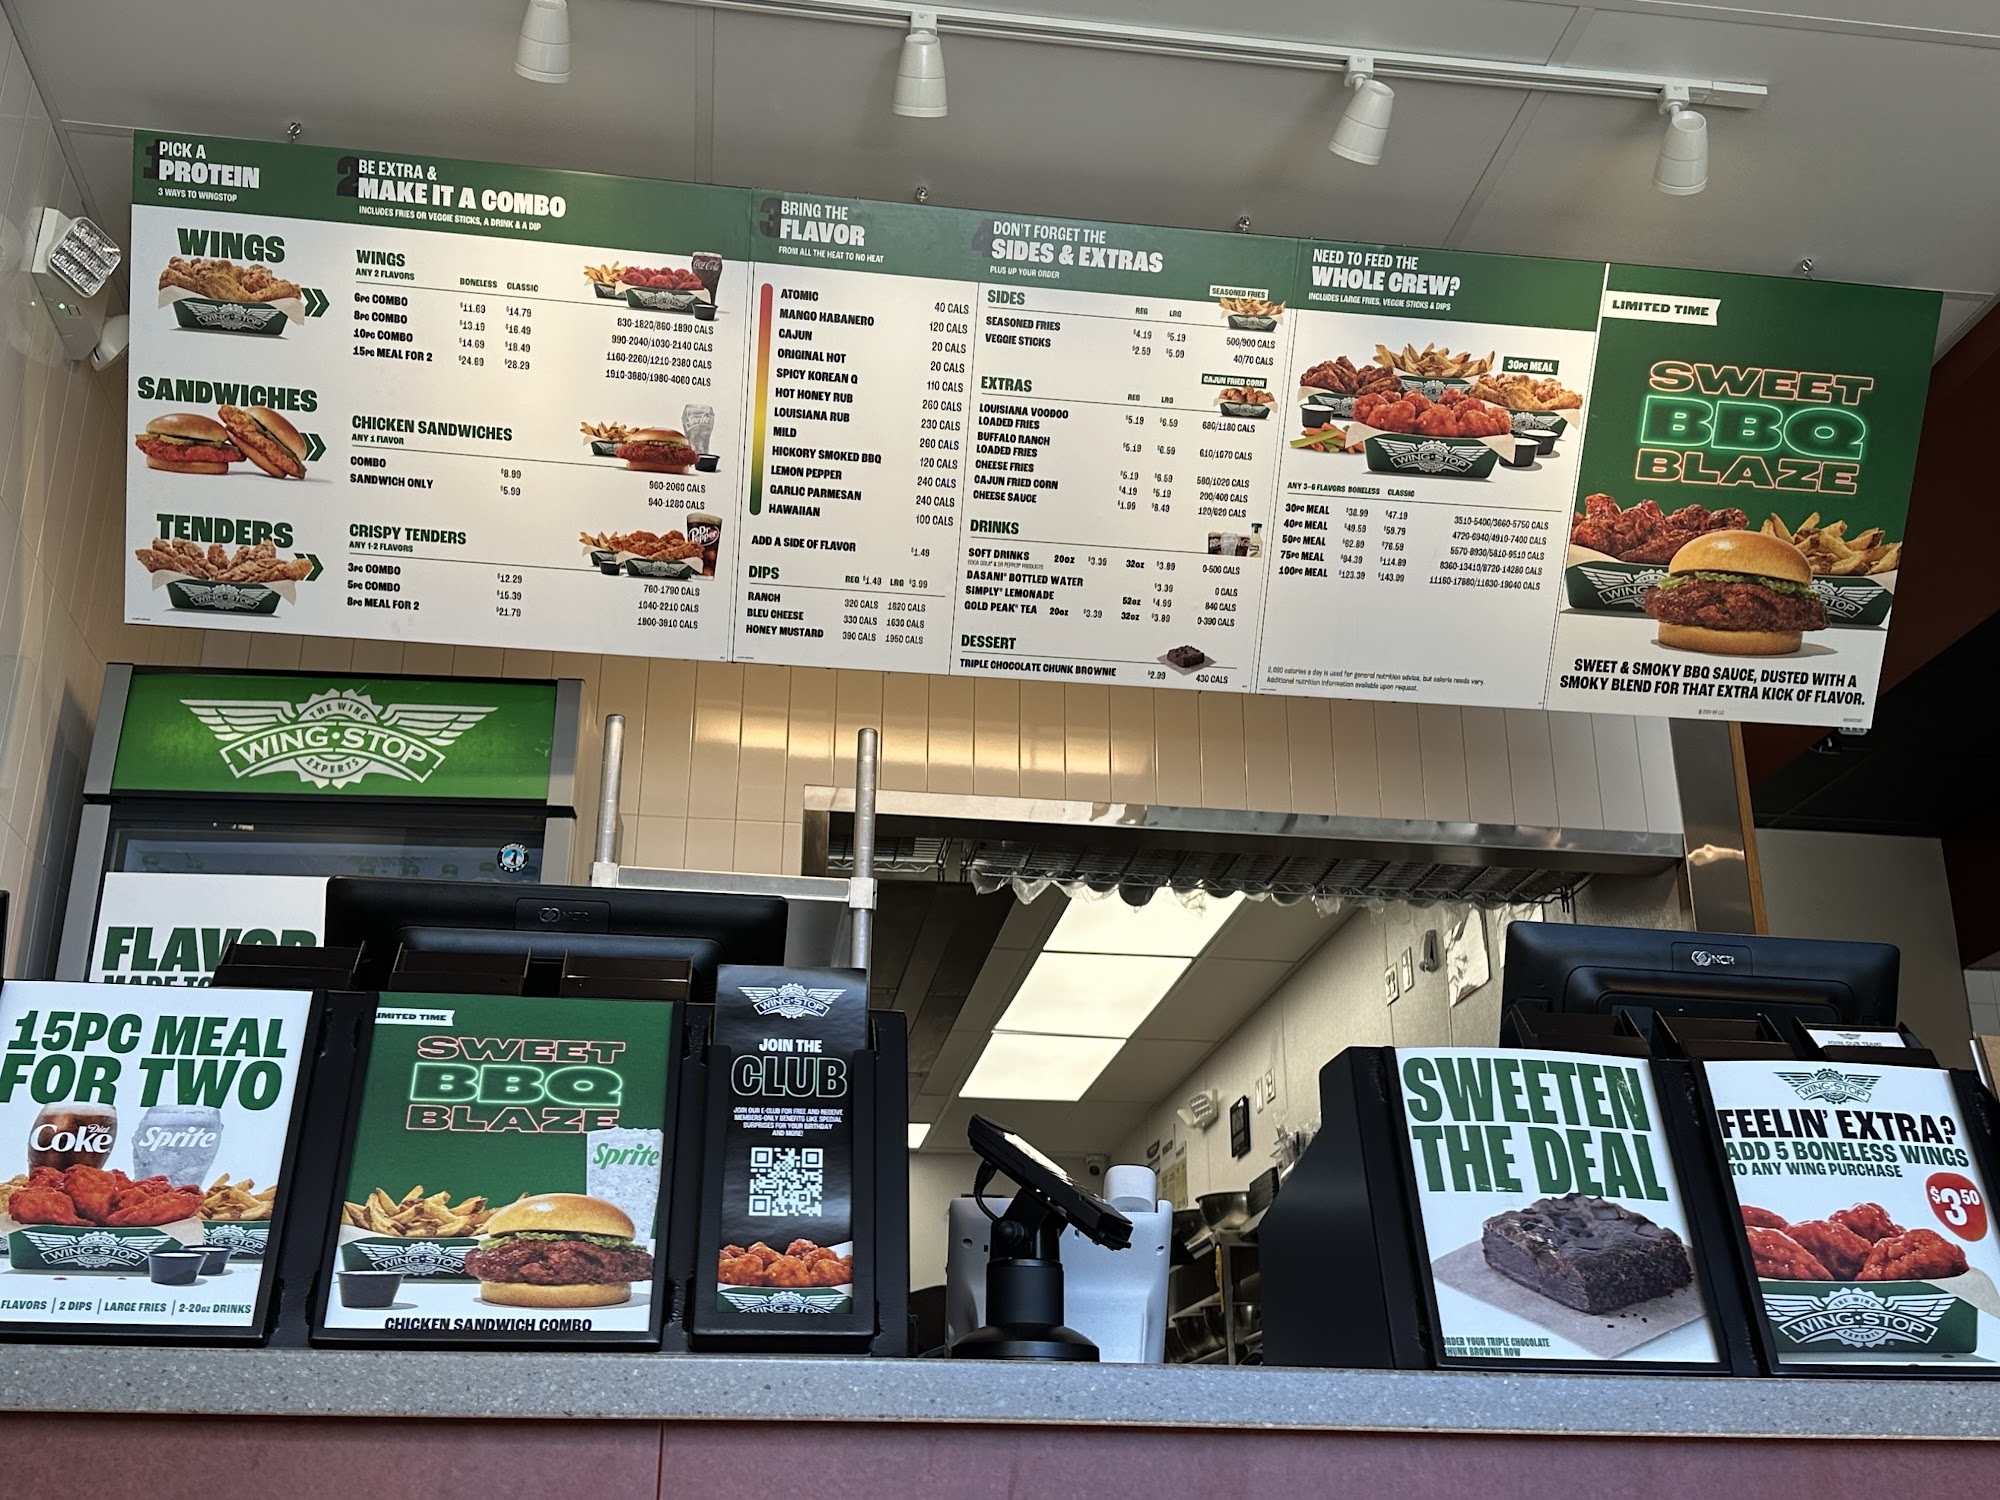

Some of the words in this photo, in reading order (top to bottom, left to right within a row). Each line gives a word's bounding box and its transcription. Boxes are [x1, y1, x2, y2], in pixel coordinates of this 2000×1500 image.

[160, 141, 192, 158] PICK
[196, 144, 206, 159] A
[159, 159, 259, 189] PROTEIN
[359, 159, 375, 174] BE
[379, 161, 423, 179] EXTRA
[427, 166, 437, 180] &
[158, 188, 163, 196] 3
[165, 188, 186, 198] WAYS
[188, 190, 196, 199] TO
[198, 191, 237, 202] WINGSTOP
[358, 178, 427, 205] MAKE
[432, 183, 454, 206] IT
[458, 187, 476, 209] A
[482, 189, 566, 218] COMBO
[359, 206, 394, 217] INCLUDES
[395, 209, 415, 219] FRIES
[416, 211, 426, 220] OR
[428, 212, 453, 222] VEGGIE
[455, 214, 482, 226] STICKS,
[484, 217, 489, 226] A
[490, 218, 513, 228] DRINK
[515, 220, 520, 228] &
[522, 221, 528, 229] A
[529, 222, 541, 231] DIP
[781, 201, 821, 218] BRING
[824, 205, 848, 221] THE
[780, 219, 865, 246] FLAVOR
[993, 221, 1031, 238] DON'T
[1034, 224, 1080, 242] FORGET
[1083, 229, 1106, 244] THE
[177, 228, 285, 263] WINGS
[356, 250, 405, 267] WINGS
[992, 238, 1054, 264] SIDES
[1058, 245, 1074, 266] &
[1079, 246, 1163, 273] EXTRAS
[1313, 248, 1344, 264] NEED
[1347, 251, 1363, 265] TO
[1365, 253, 1393, 268] FEED
[1396, 256, 1418, 270] THE
[356, 268, 372, 277] ANY
[374, 269, 379, 277] 2
[381, 270, 414, 280] FLAVORS
[1312, 265, 1384, 291] WHOLE
[1388, 272, 1461, 296] CREW?
[460, 278, 497, 288] BONELESS
[507, 282, 538, 292] CLASSIC
[781, 288, 819, 301] ATOMIC
[987, 289, 1025, 306] SIDES
[780, 308, 817, 321] MANGO
[819, 311, 874, 326] HABANERO
[1612, 300, 1670, 314] LIMITED
[1674, 304, 1709, 316] TIME
[779, 328, 812, 341] CAJUN
[929, 322, 944, 333] 120
[946, 322, 968, 334] CALS
[777, 348, 824, 362] ORIGINAL
[826, 352, 846, 363] HOT
[776, 368, 806, 380] SPICY
[808, 370, 849, 383] KOREAN
[851, 374, 858, 384] Q
[981, 376, 1032, 392] EXTRAS
[1649, 360, 1874, 405] SWEET
[138, 376, 317, 412] SANDWICHES
[775, 388, 796, 399] HOT
[797, 389, 831, 402] HONEY
[833, 392, 853, 404] RUB
[774, 407, 828, 421] LOUISIANA
[830, 412, 850, 422] RUB
[352, 415, 414, 433] CHICKEN
[418, 421, 512, 441] SANDWICHES
[773, 426, 797, 438] MILD
[1640, 395, 1866, 460] BBQ
[772, 446, 816, 459] HICKORY
[818, 449, 859, 462] SMOKED
[862, 453, 882, 464] BBQ
[771, 465, 804, 477] LEMON
[806, 468, 842, 480] PEPPER
[1635, 448, 1860, 495] BLAZE
[350, 473, 405, 487] SANDWICH
[407, 477, 433, 489] ONLY
[770, 484, 805, 497] GARLIC
[807, 487, 862, 501] PARMESAN
[768, 504, 820, 517] HAWAIIAN
[157, 513, 293, 548] TENDERS
[350, 524, 401, 540] CRISPY
[405, 528, 467, 544] TENDERS
[970, 519, 1019, 535] DRINKS
[749, 565, 779, 579] DIPS
[748, 592, 781, 602] RANCH
[961, 634, 1016, 650] DESSERT
[1574, 658, 1618, 674] SWEET
[1620, 661, 1629, 674] &
[1632, 662, 1682, 678] SMOKY
[1683, 665, 1710, 679] BBQ
[1713, 667, 1757, 683] SAUCE,
[1760, 670, 1809, 685] DUSTED
[1812, 672, 1845, 686] WITH
[1847, 674, 1857, 688] A
[1560, 675, 1609, 691] SMOKY
[1611, 678, 1652, 693] BLEND
[1654, 681, 1679, 694] FOR
[1682, 683, 1715, 696] THAT
[1716, 684, 1759, 699] EXTRA
[1762, 687, 1794, 701] KICK
[1796, 689, 1813, 702] OF
[1814, 690, 1866, 705] FLAVOR.
[309, 702, 333, 719] THE
[338, 701, 369, 720] WING
[305, 757, 359, 773] EXPERTS
[1712, 955, 1735, 964] NCR
[7, 1010, 143, 1053] 15PC
[151, 1015, 287, 1058] MEAL
[417, 1036, 626, 1064] SWEET
[759, 1039, 793, 1052] JOIN
[796, 1040, 822, 1053] THE
[0, 1054, 121, 1105] FOR
[139, 1058, 282, 1111] TWO
[410, 1062, 623, 1106] BBQ
[731, 1055, 847, 1098] CLUB
[1402, 1057, 1651, 1131] SWEETEN
[406, 1104, 619, 1133] BLAZE
[1835, 1110, 1956, 1144] EXTRA?
[30, 1124, 112, 1153] Coke
[138, 1126, 217, 1152] Sprite
[593, 1143, 660, 1170] Sprite
[1725, 1141, 1769, 1161] ADD
[1777, 1142, 1791, 1160] 5
[1793, 1142, 1898, 1163] BONELESS
[1900, 1145, 1969, 1167] WINGS
[1411, 1125, 1523, 1193] THE
[1527, 1126, 1668, 1202] DEAL
[1752, 1163, 1781, 1176] ANY
[1788, 1163, 1826, 1175] WING
[1830, 1164, 1902, 1178] PURCHASE
[0, 1300, 47, 1310] FLAVORS
[59, 1301, 66, 1311] 2
[68, 1302, 92, 1311] DIPS
[104, 1302, 136, 1312] LARGE
[138, 1303, 166, 1312] FRIES
[212, 1304, 251, 1314] DRINKS
[385, 1318, 450, 1330] CHICKEN
[454, 1319, 536, 1331] SANDWICH
[539, 1319, 592, 1331] COMBO
[1466, 1337, 1485, 1346] YOUR
[1486, 1337, 1510, 1346] TRIPLE
[1511, 1338, 1550, 1347] CHOCOLATE
[1469, 1347, 1502, 1356] BROWNIE
[1504, 1348, 1520, 1356] NOW
